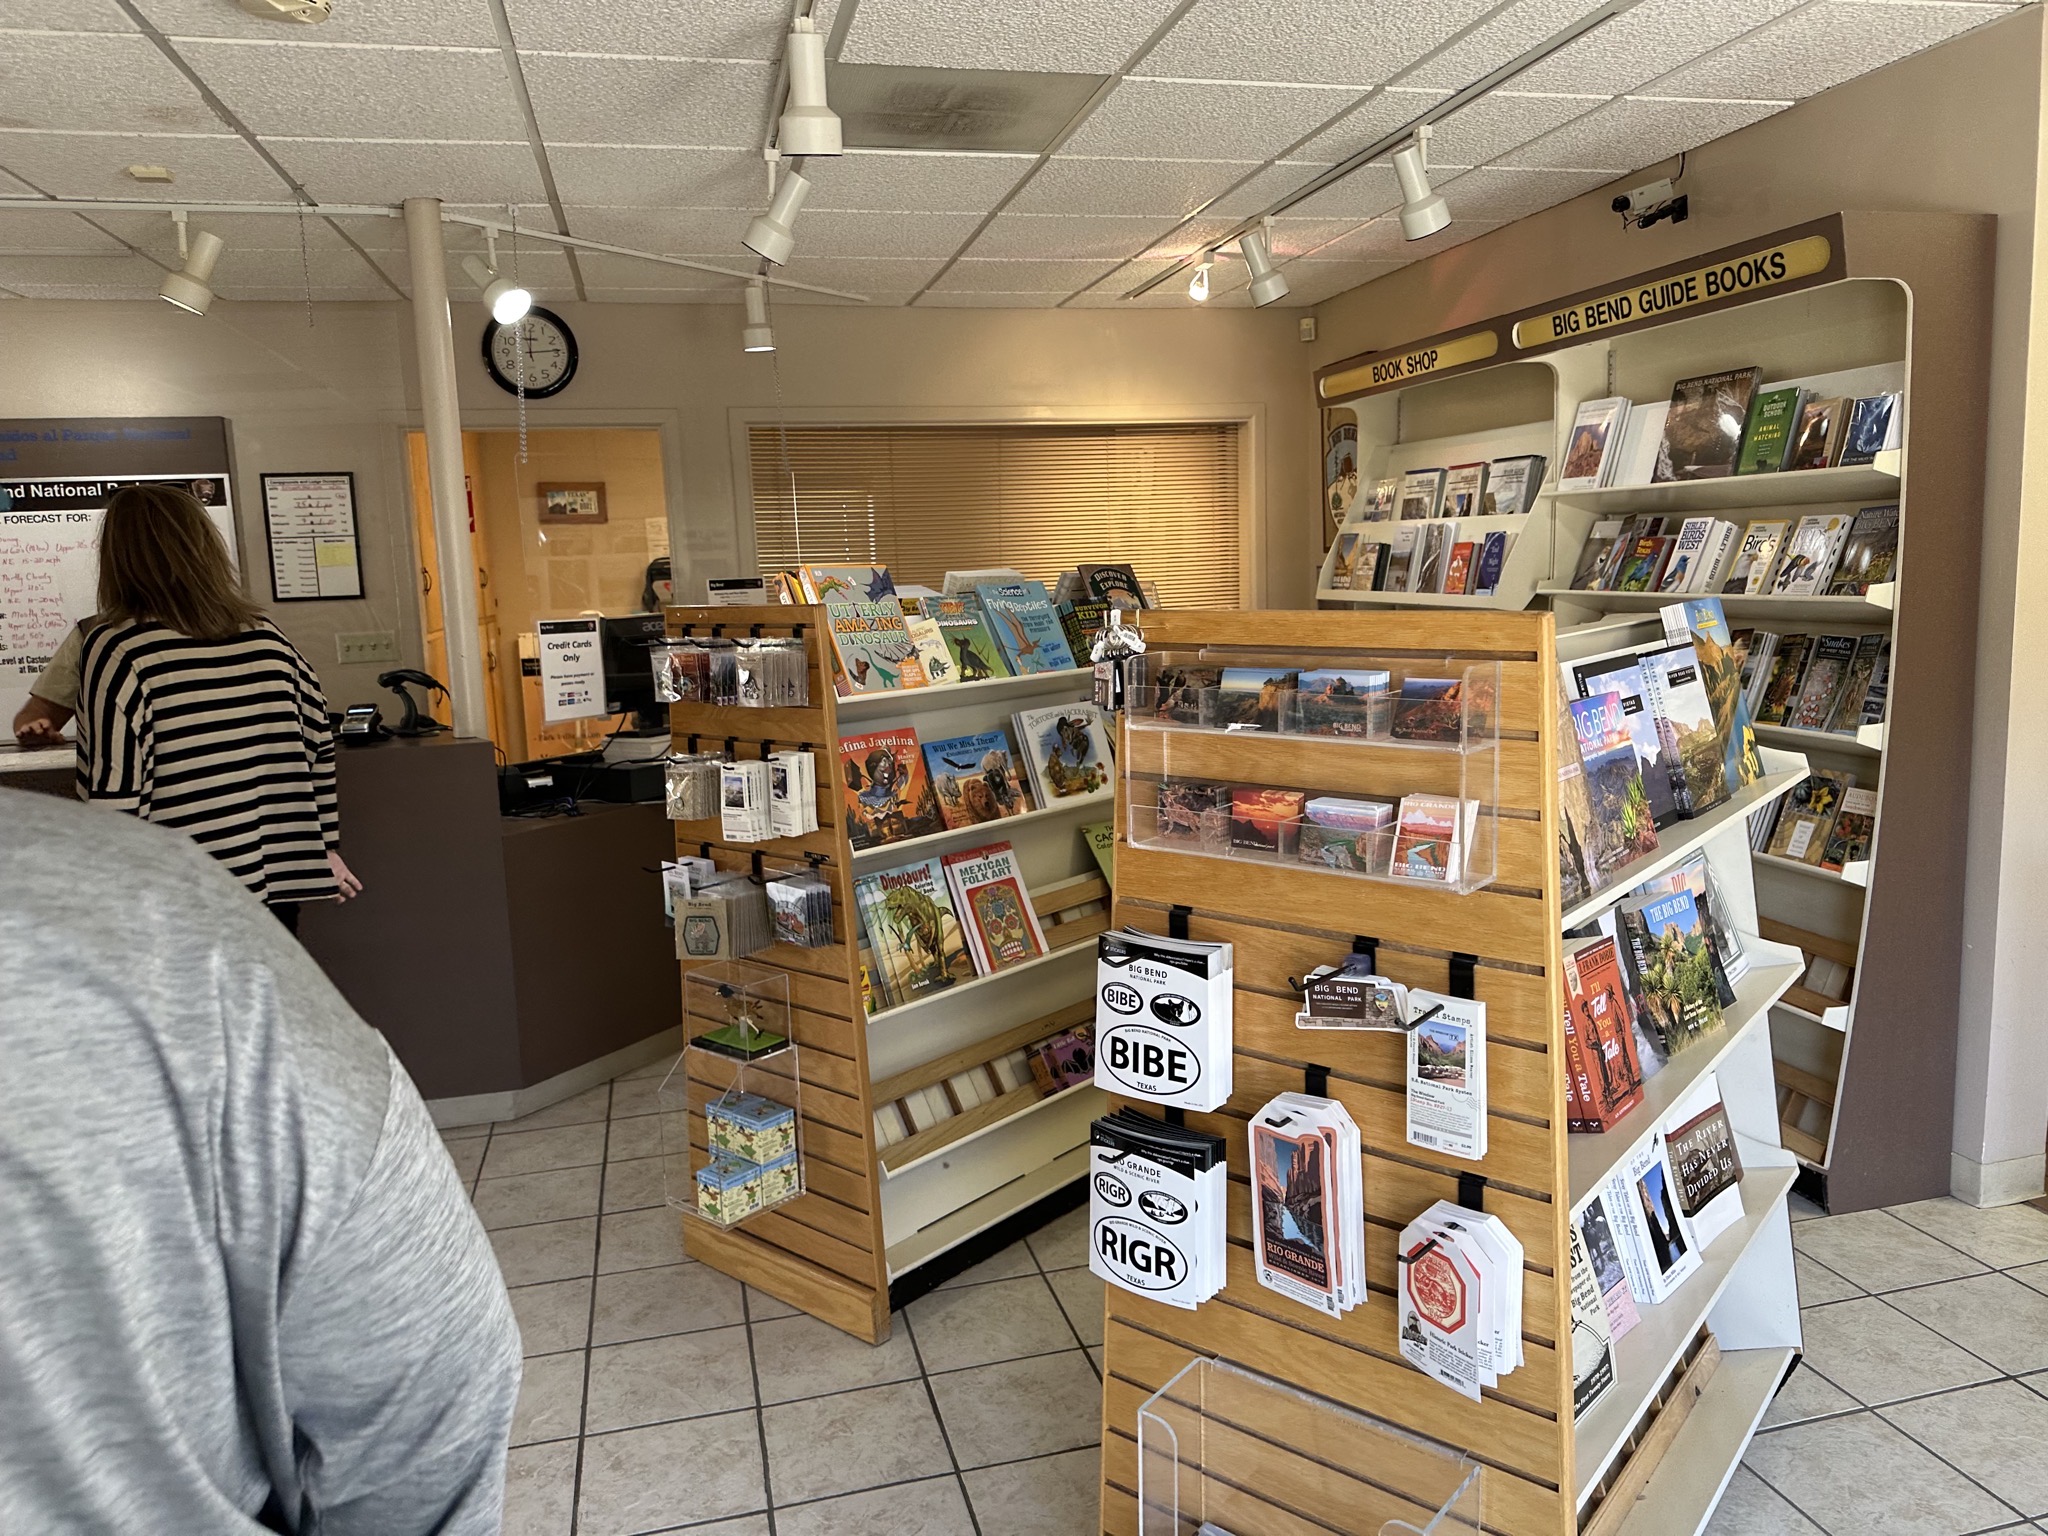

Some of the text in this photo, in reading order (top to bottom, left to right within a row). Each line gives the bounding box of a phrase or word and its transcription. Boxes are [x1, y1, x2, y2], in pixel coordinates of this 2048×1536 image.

[1552, 252, 1786, 336] BIG BEND GUIDE BOOKS
[541, 327, 545, 335] 1
[504, 337, 516, 346] 10
[548, 336, 556, 345] 2
[502, 348, 510, 357] 9
[552, 349, 560, 357] 3
[506, 360, 515, 369] 8
[551, 361, 557, 369] 4
[1372, 350, 1438, 383] BOOK SHOP
[529, 374, 537, 382] 6
[541, 370, 549, 379] 5
[1703, 375, 1734, 386] NATIONAL
[1735, 371, 1752, 381] PARK
[1763, 401, 1787, 411] OUTDOOR
[1763, 409, 1783, 418] SCHOOL
[1759, 423, 1780, 432] ANIMAL
[1753, 432, 1781, 441] WATCHING
[31, 483, 102, 498] National
[4, 513, 92, 524] FORECAST FOR:
[1683, 521, 1709, 530] SIBLEY
[1681, 530, 1706, 540] BIRDS
[1678, 540, 1702, 550] WEST
[1709, 525, 1732, 580] SIBLEY BIRDS
[998, 587, 1024, 596] Science
[828, 602, 895, 618] UTTERLY
[986, 598, 1048, 613] Flying Reptiles
[1075, 603, 1109, 611] SURVIVOR
[12, 608, 38, 624] Mostly
[1077, 611, 1098, 620] KID
[835, 617, 903, 633] AMAZING
[547, 640, 592, 650] Credit Cards
[838, 631, 908, 646] DINOSAUR
[1824, 637, 1850, 649] Snakes
[18, 657, 24, 665] at
[563, 653, 580, 662] Only
[19, 666, 26, 674] at
[1029, 713, 1054, 729] TORTOISE
[1591, 703, 1620, 734] BEND
[839, 735, 914, 754] efina Javelina
[932, 735, 999, 753] Will We Miss Them?
[1095, 832, 1113, 843] CAC
[1096, 841, 1113, 850] Color
[959, 857, 1010, 878] MEXICAN
[1415, 863, 1446, 872] BEND
[879, 864, 932, 891] Dinosaurs!
[962, 865, 1012, 887] FOLK ART
[915, 881, 934, 889] Coloring
[1650, 895, 1690, 923] THE BIG BEND
[1582, 955, 1600, 972] FRANK
[1599, 948, 1615, 964] DOBIE
[1128, 964, 1168, 978] BIG BEND
[1129, 973, 1152, 983] NATIONAL
[1336, 986, 1359, 994] BEND
[1590, 981, 1601, 995] I'll
[1107, 988, 1136, 1009] BIBE
[1591, 992, 1607, 1018] Tell
[1413, 1006, 1440, 1019] Tral
[1597, 1017, 1612, 1031] You
[1141, 1029, 1160, 1038] NATIONAL
[1563, 1010, 1591, 1102] Tell You a Tale
[1602, 1037, 1619, 1063] Tale
[1110, 1035, 1188, 1085] BIBE
[1136, 1081, 1157, 1091] TEXAS
[1420, 1080, 1441, 1089] National
[1676, 1119, 1724, 1156] THE RIVER
[1681, 1139, 1728, 1177] HAS NEVER
[1126, 1160, 1162, 1178] GRANDE
[1632, 1154, 1651, 1177] Big Bend
[1113, 1165, 1124, 1173] WILD
[1128, 1171, 1145, 1181] SCENIC
[1145, 1176, 1160, 1184] RIVER
[1686, 1156, 1732, 1198] DIVIDED US
[1099, 1177, 1126, 1202] RIGR
[1101, 1224, 1177, 1282] RIGR
[1267, 1241, 1325, 1273] RIO GRANDE
[1580, 1266, 1588, 1276] the
[1126, 1273, 1146, 1286] TEXAS
[1571, 1285, 1595, 1308] Big Bend
[1580, 1294, 1598, 1312] National
[1589, 1304, 1600, 1316] Park
[1429, 1331, 1446, 1344] Historic
[1447, 1341, 1457, 1351] Park
[1458, 1347, 1474, 1360] Sticker
[1581, 1393, 1590, 1406] First
